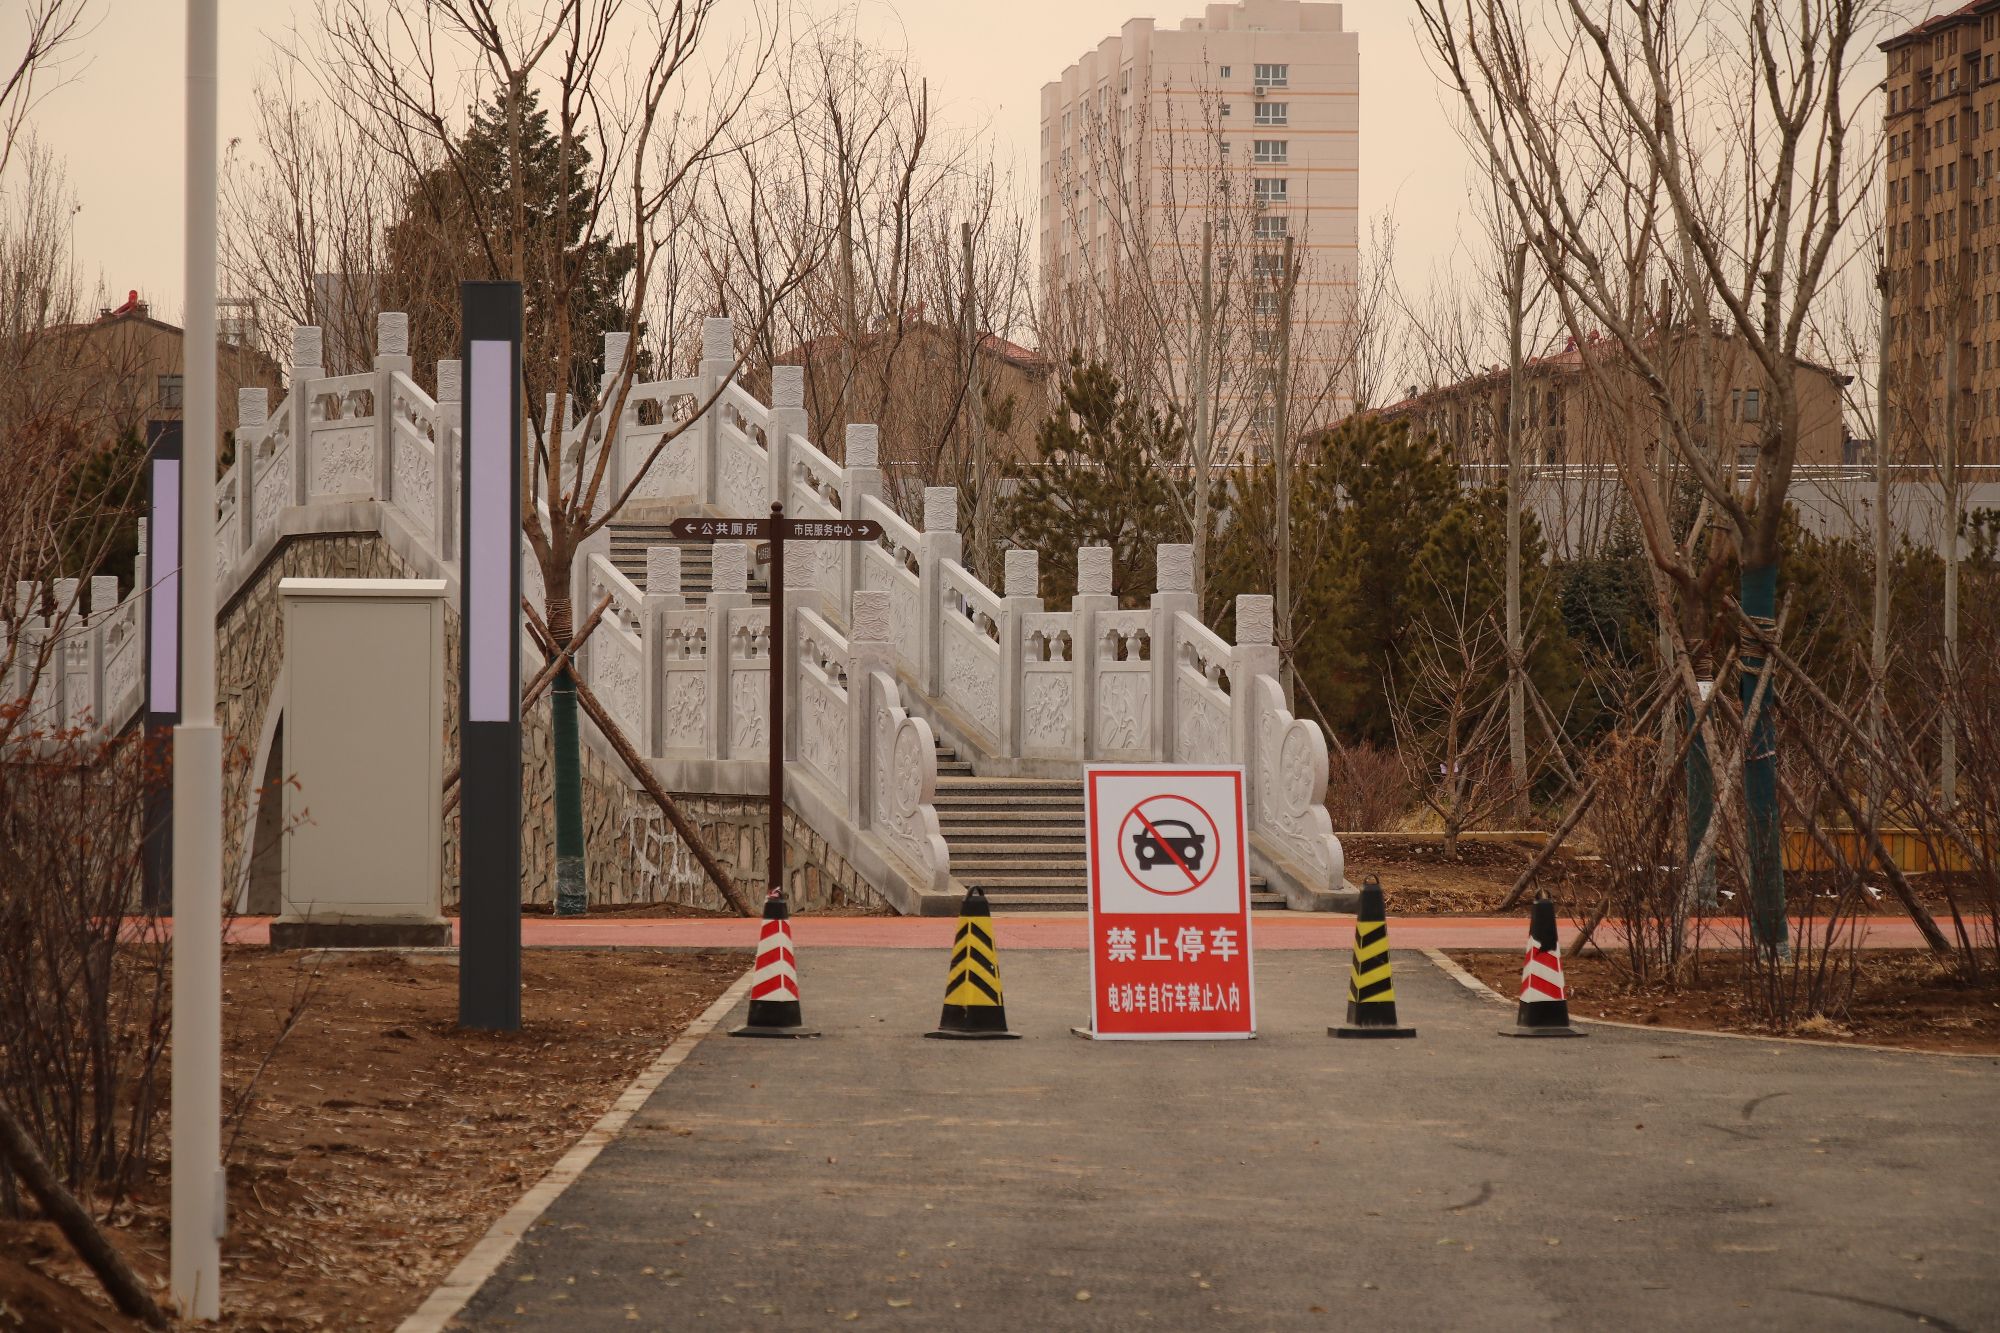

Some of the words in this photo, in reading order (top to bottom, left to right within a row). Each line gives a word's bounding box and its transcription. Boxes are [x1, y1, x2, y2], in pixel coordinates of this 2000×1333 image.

[701, 522, 758, 536] 公共厕所
[794, 523, 853, 537] 市民服务中心
[1107, 926, 1239, 962] 禁止停车
[1108, 982, 1240, 1013] 电动车自行车禁止入内
